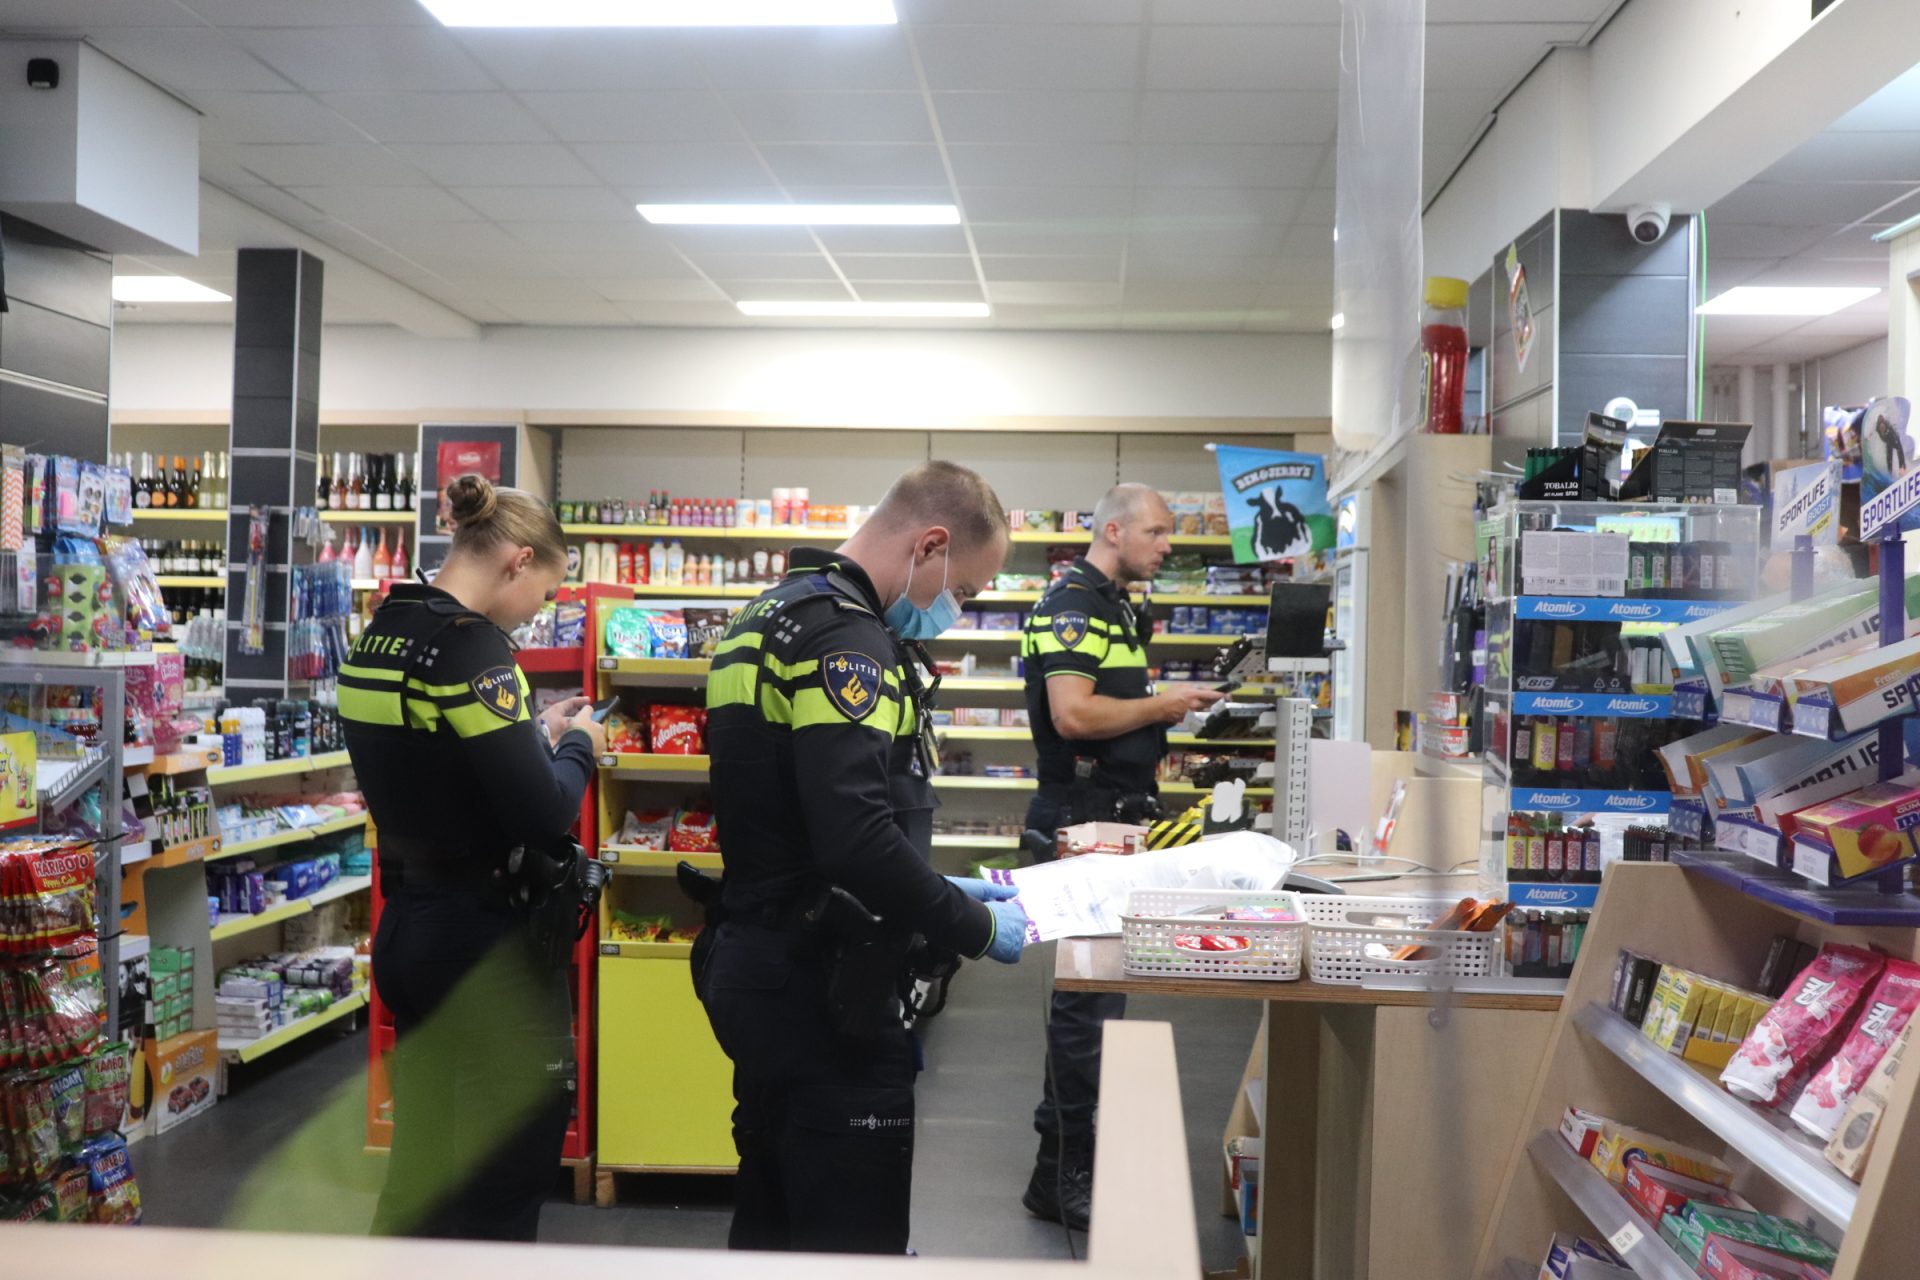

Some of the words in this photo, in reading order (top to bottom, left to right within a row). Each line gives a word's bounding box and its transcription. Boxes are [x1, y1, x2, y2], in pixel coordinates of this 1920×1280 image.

[1544, 482, 1579, 490] TOBALIQ
[1780, 478, 1826, 531] SPORTLIFE
[1863, 471, 1920, 532] SPORTLIFE
[1807, 499, 1831, 521] BOOST
[1534, 601, 1577, 614] Atomic
[1609, 603, 1652, 616] Atomic
[829, 657, 877, 677] POLITIE
[478, 672, 513, 691] POLITIE
[1528, 678, 1552, 688] BIC
[1531, 697, 1574, 708] Atomic
[1607, 699, 1650, 711] Atomic
[1529, 793, 1571, 805] Atomic
[1604, 795, 1647, 807] Atomic
[33, 855, 76, 877] HARIBO
[1526, 889, 1568, 900] Atomic
[862, 1115, 902, 1130] POLITIE
[95, 1152, 126, 1174] HARIBO
